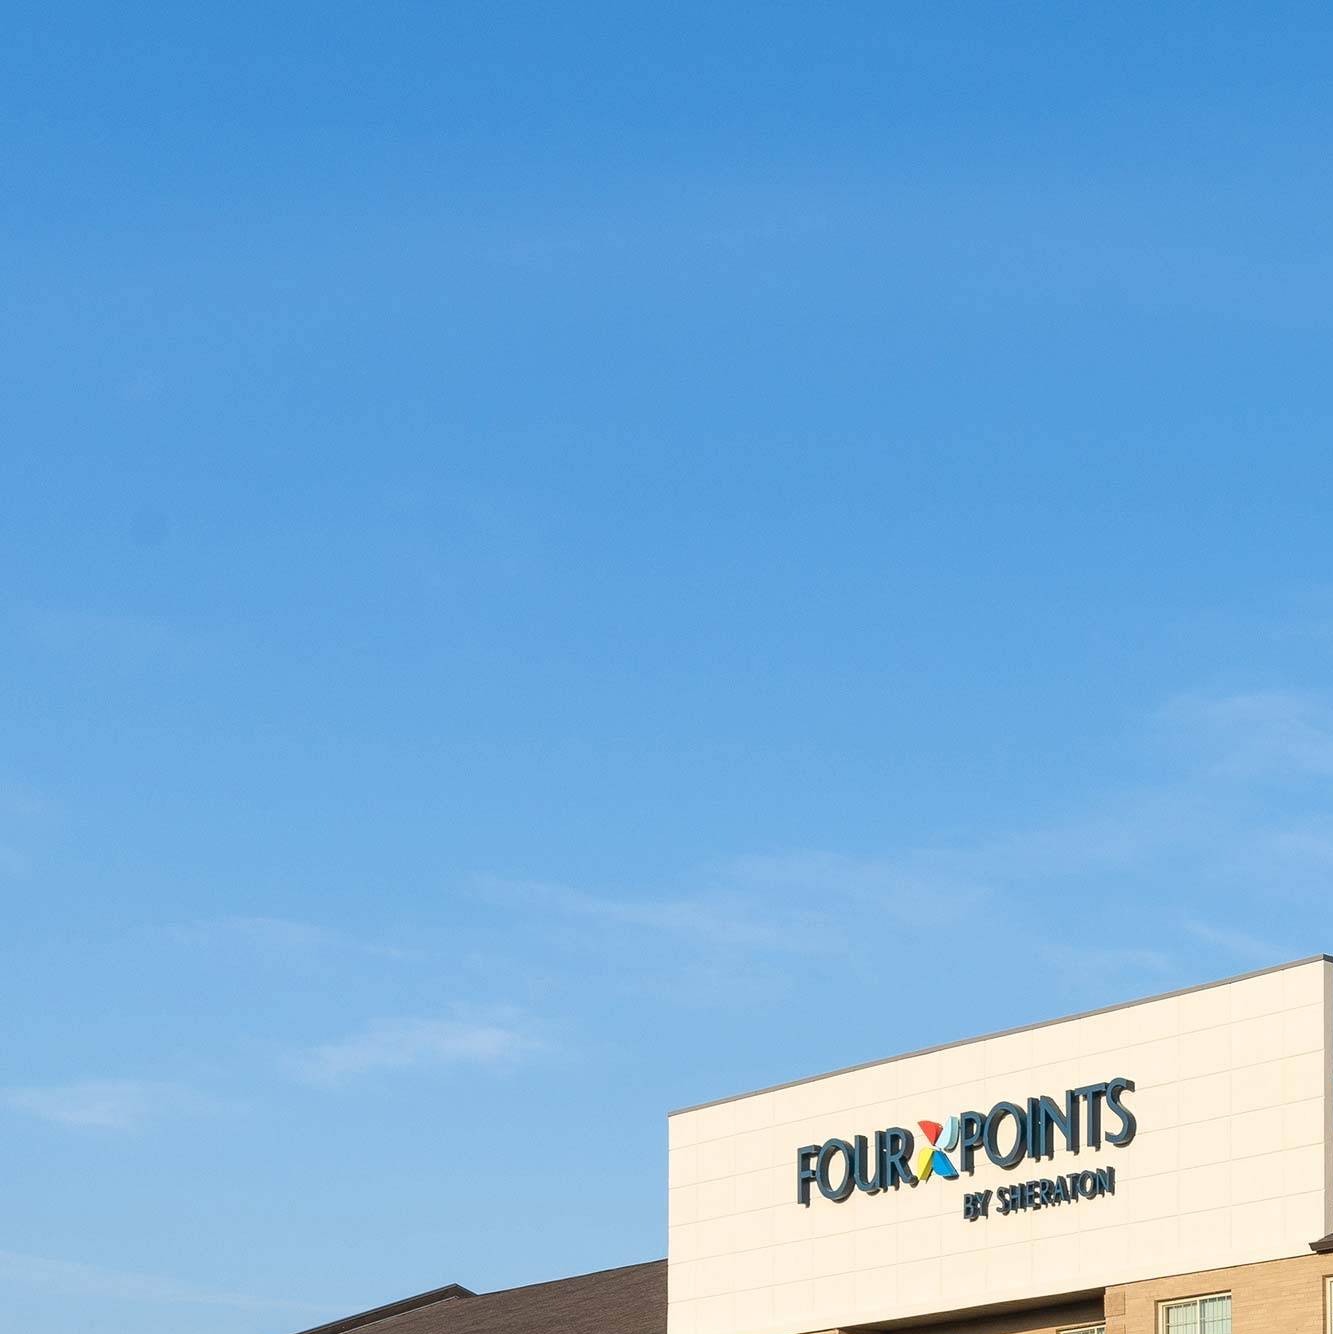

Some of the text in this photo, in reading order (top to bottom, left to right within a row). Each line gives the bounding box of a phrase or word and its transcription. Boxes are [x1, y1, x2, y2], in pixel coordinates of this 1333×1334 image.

[797, 1077, 1137, 1208] FOUR POINTS
[963, 1166, 1115, 1222] BY SHERATON
